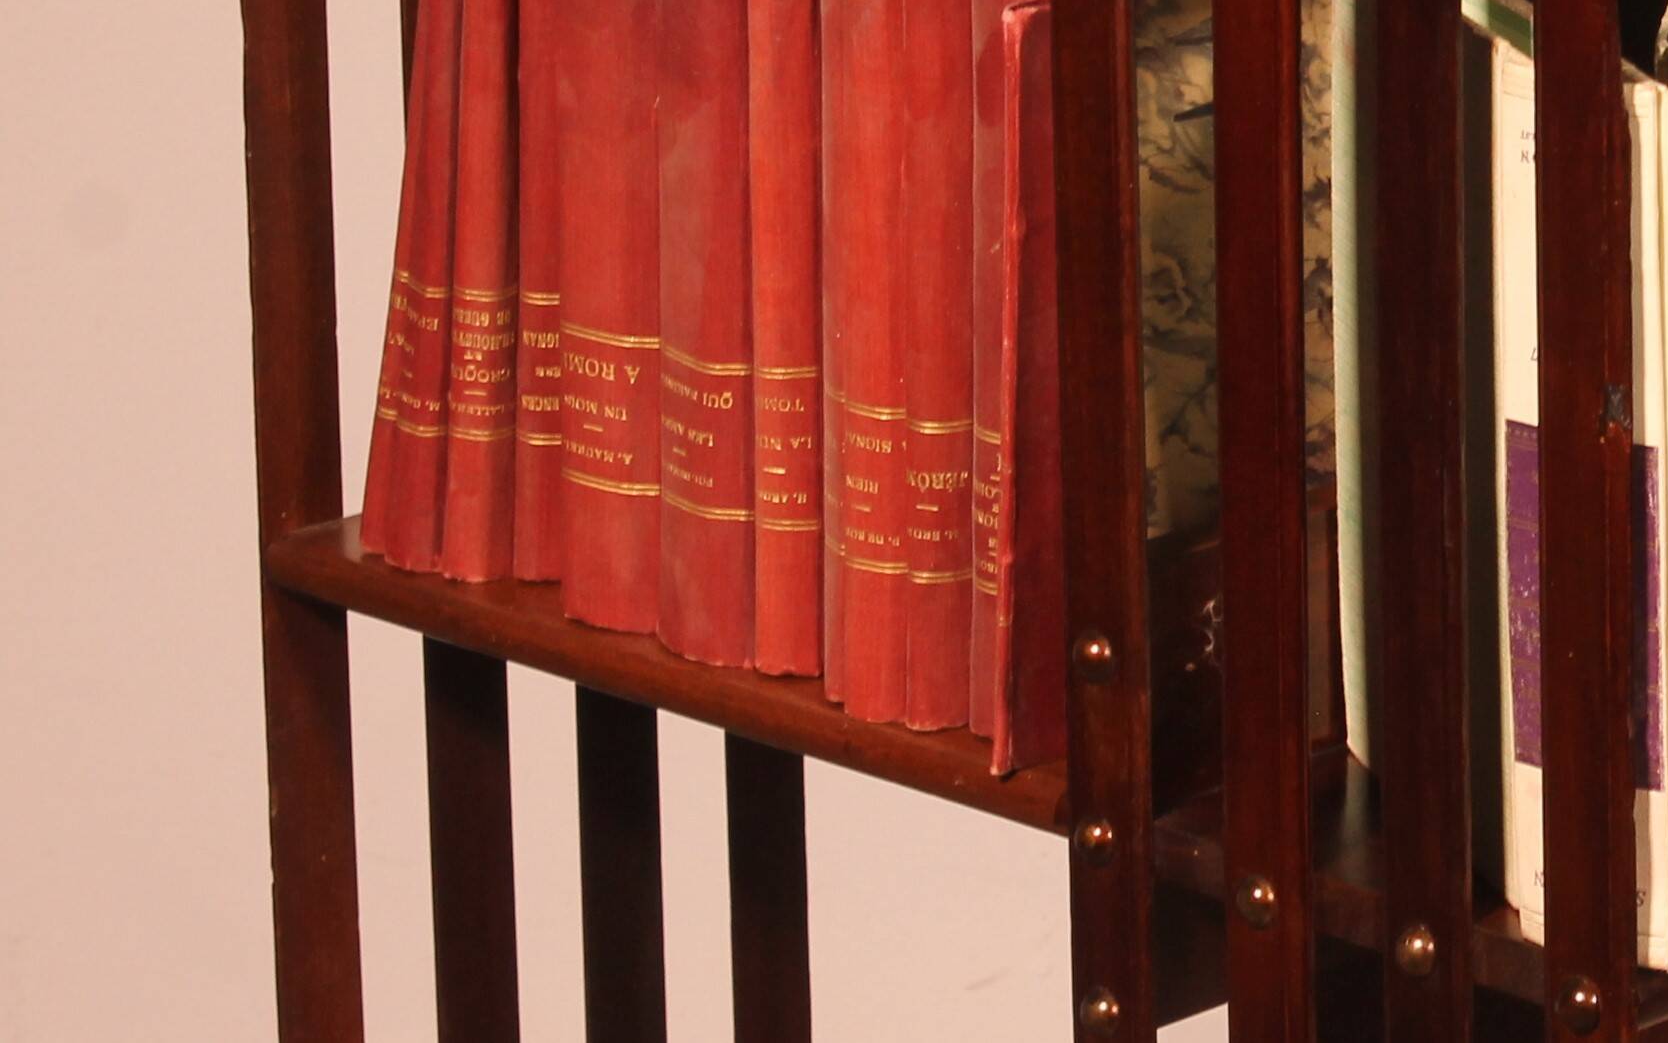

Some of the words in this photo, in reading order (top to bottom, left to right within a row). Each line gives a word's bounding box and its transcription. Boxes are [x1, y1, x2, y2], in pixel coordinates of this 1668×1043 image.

[563, 351, 616, 382] ROM
[702, 391, 733, 410] QUI
[603, 404, 627, 422] UN
[789, 435, 811, 449] LA
[617, 452, 633, 465] A.
[844, 473, 879, 495] RIEN
